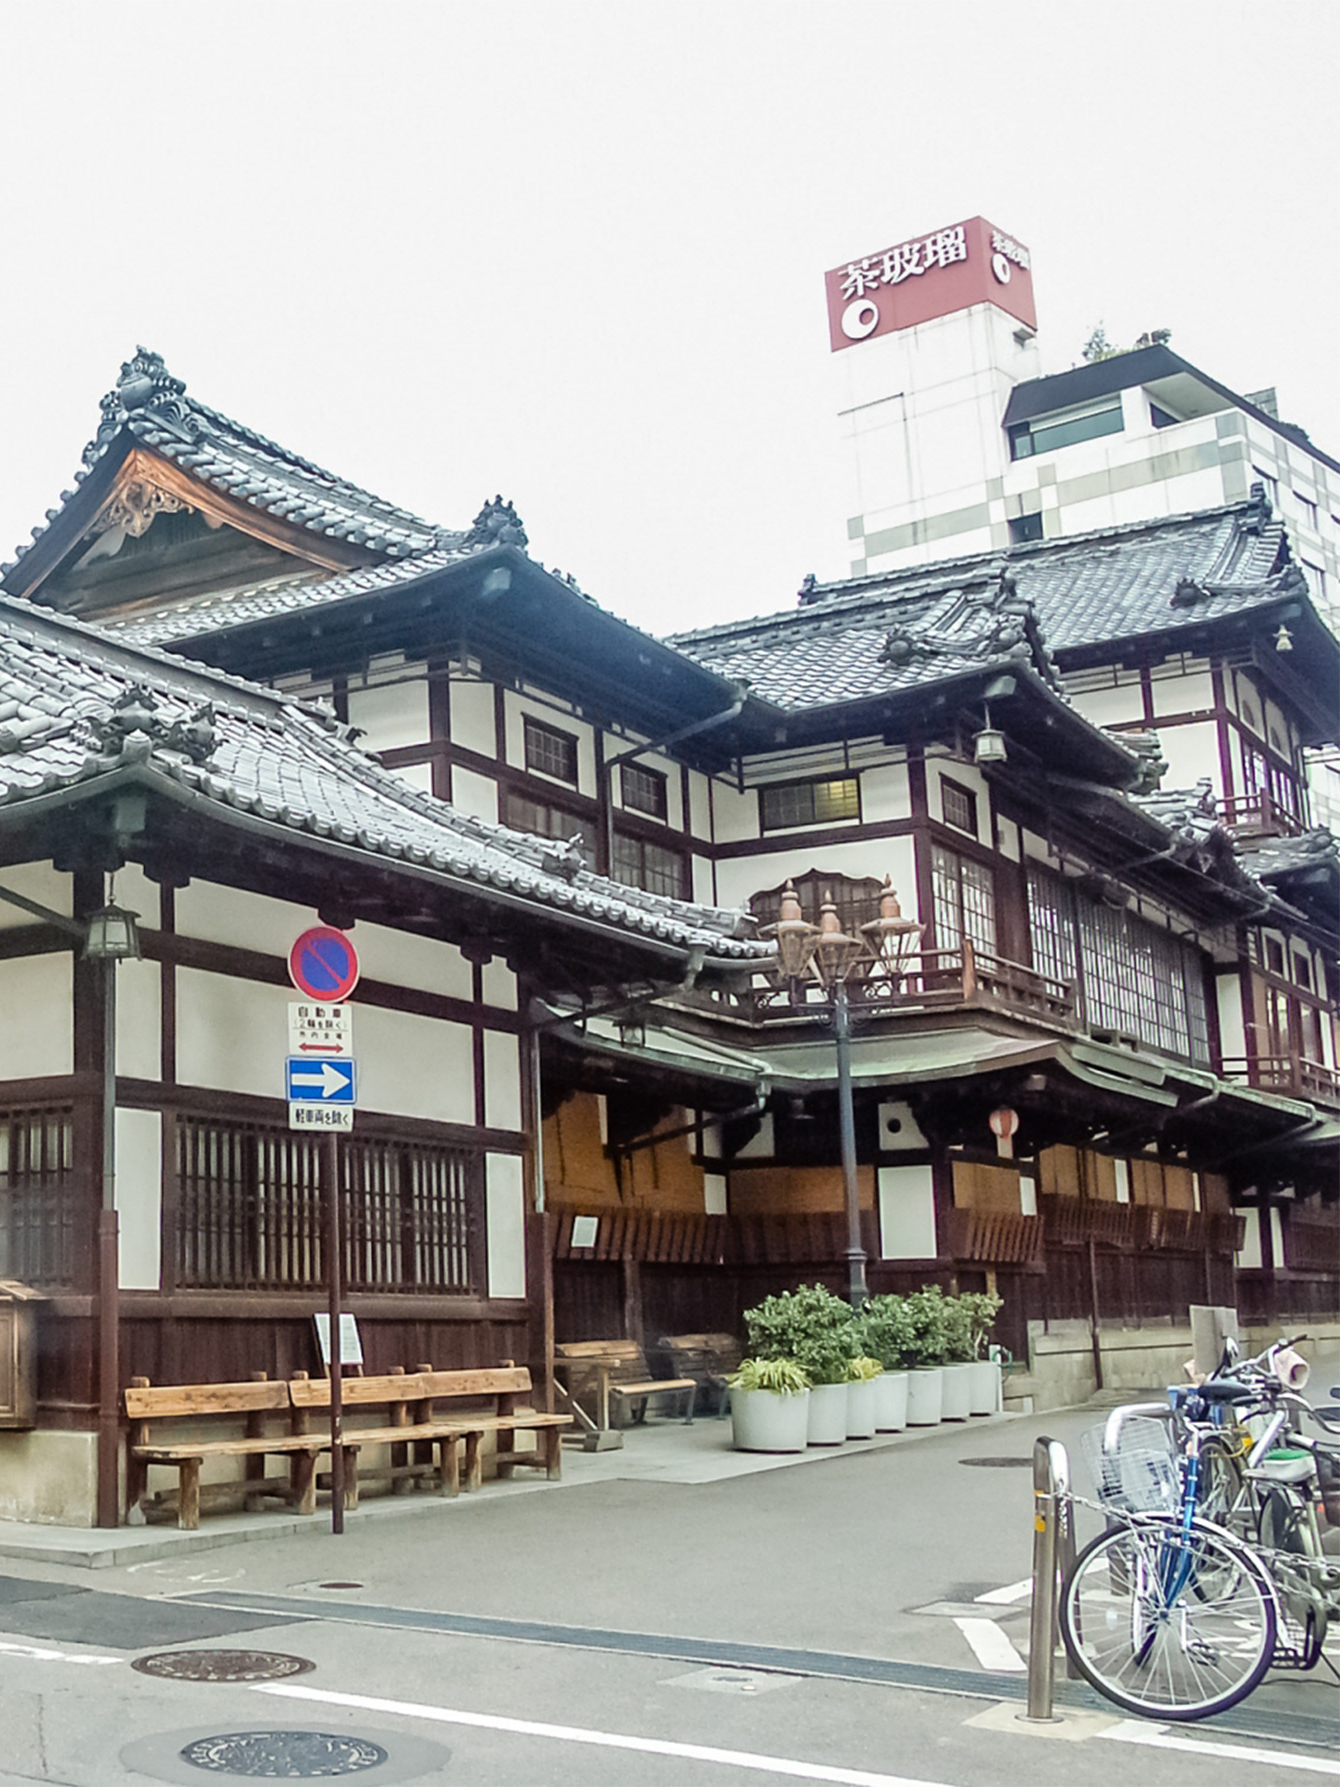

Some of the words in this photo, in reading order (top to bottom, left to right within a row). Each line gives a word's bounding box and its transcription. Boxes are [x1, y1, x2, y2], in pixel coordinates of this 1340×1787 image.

[838, 225, 968, 300] 茶玻瑠
[298, 1006, 342, 1018] 自動車
[295, 1108, 349, 1126] 軽車両を除く
